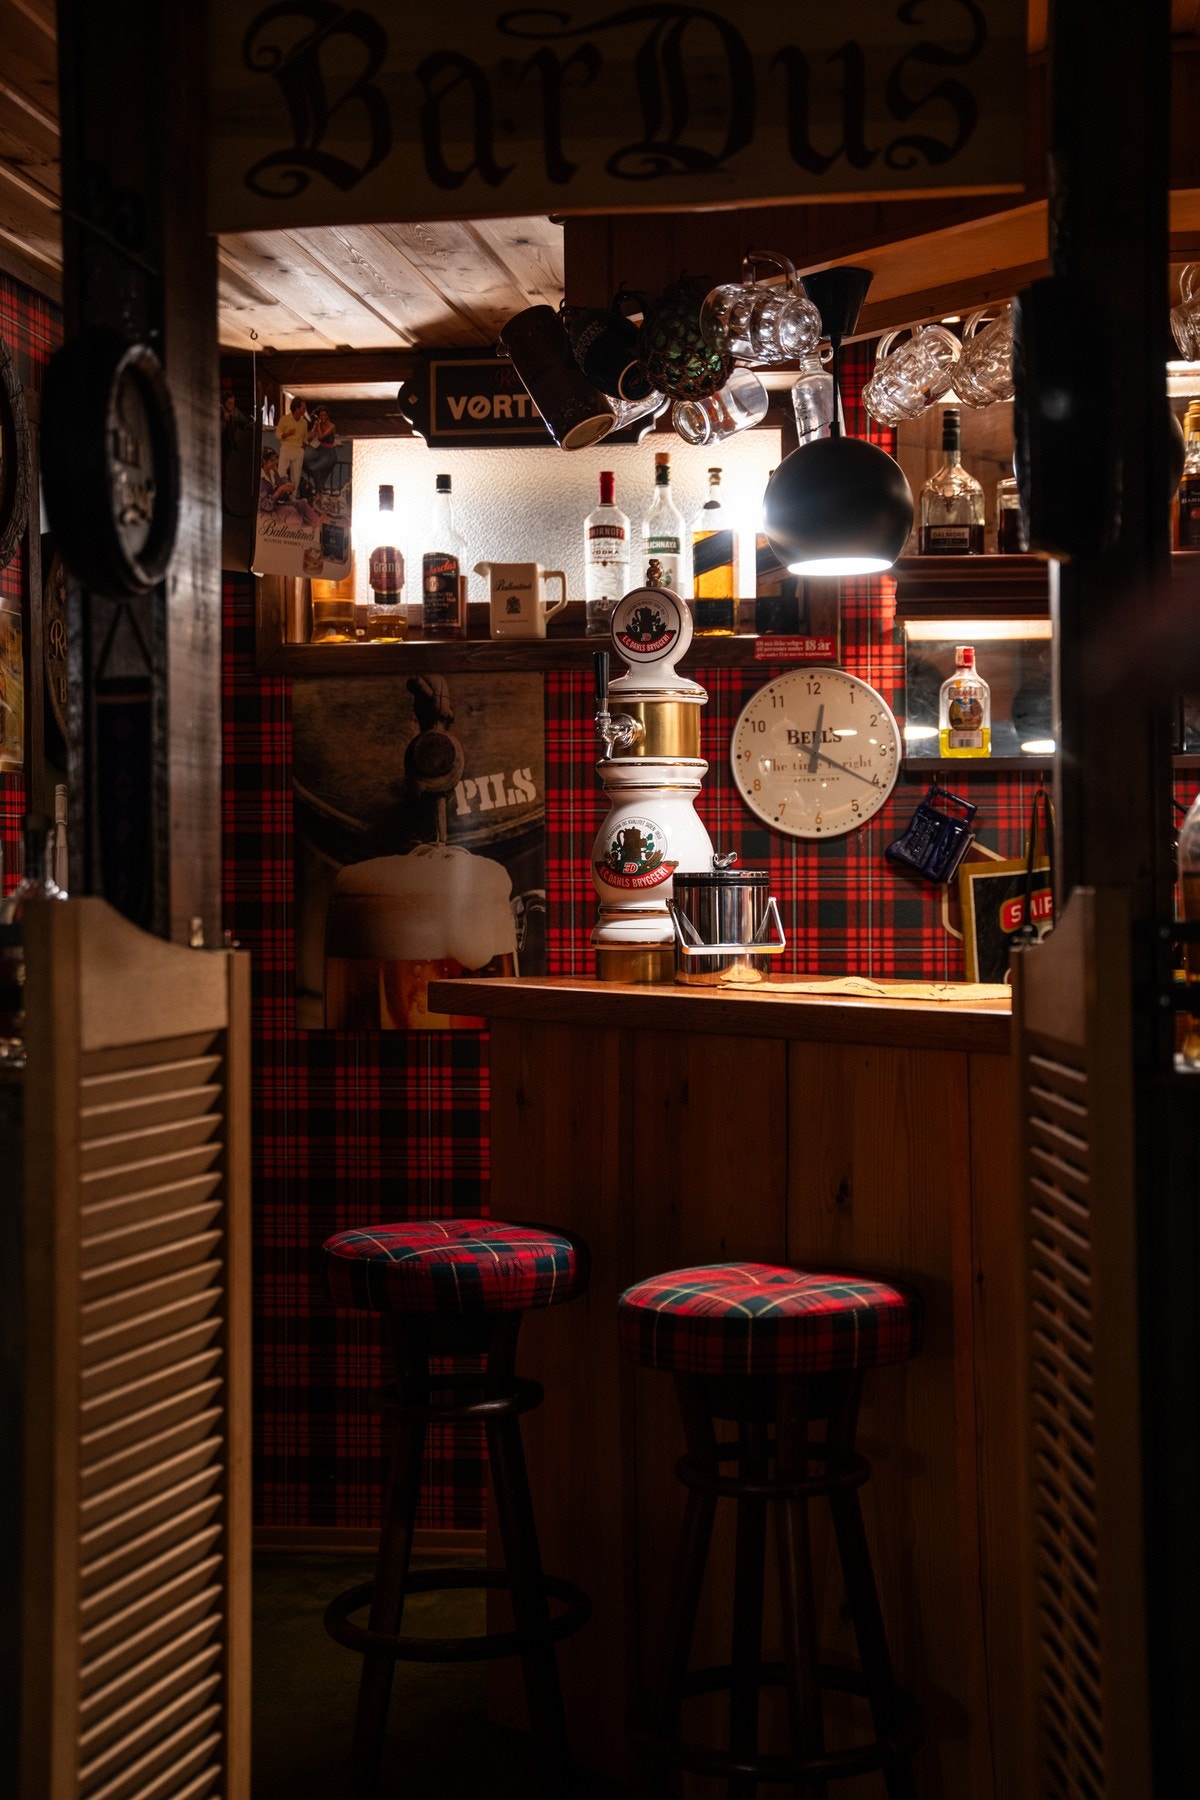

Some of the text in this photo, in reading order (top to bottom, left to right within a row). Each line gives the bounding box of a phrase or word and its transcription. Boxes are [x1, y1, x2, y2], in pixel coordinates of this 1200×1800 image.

[630, 642, 646, 652] DAHLS
[647, 634, 670, 652] BRYGGERI
[805, 639, 832, 651] 18 år
[806, 682, 821, 695] 12
[771, 696, 785, 708] 11
[849, 692, 855, 704] 1
[751, 720, 766, 733] 10
[870, 714, 878, 727] 2
[744, 750, 752, 762] 9
[879, 743, 887, 756] 3
[843, 755, 872, 770] right
[753, 779, 761, 791] 8
[871, 773, 880, 785] 4
[454, 767, 536, 816] PILS
[778, 803, 786, 816] 7
[851, 799, 859, 812] 5
[815, 812, 823, 825] 6
[608, 873, 630, 888] DAHLS
[632, 867, 669, 888] BRYGGERI
